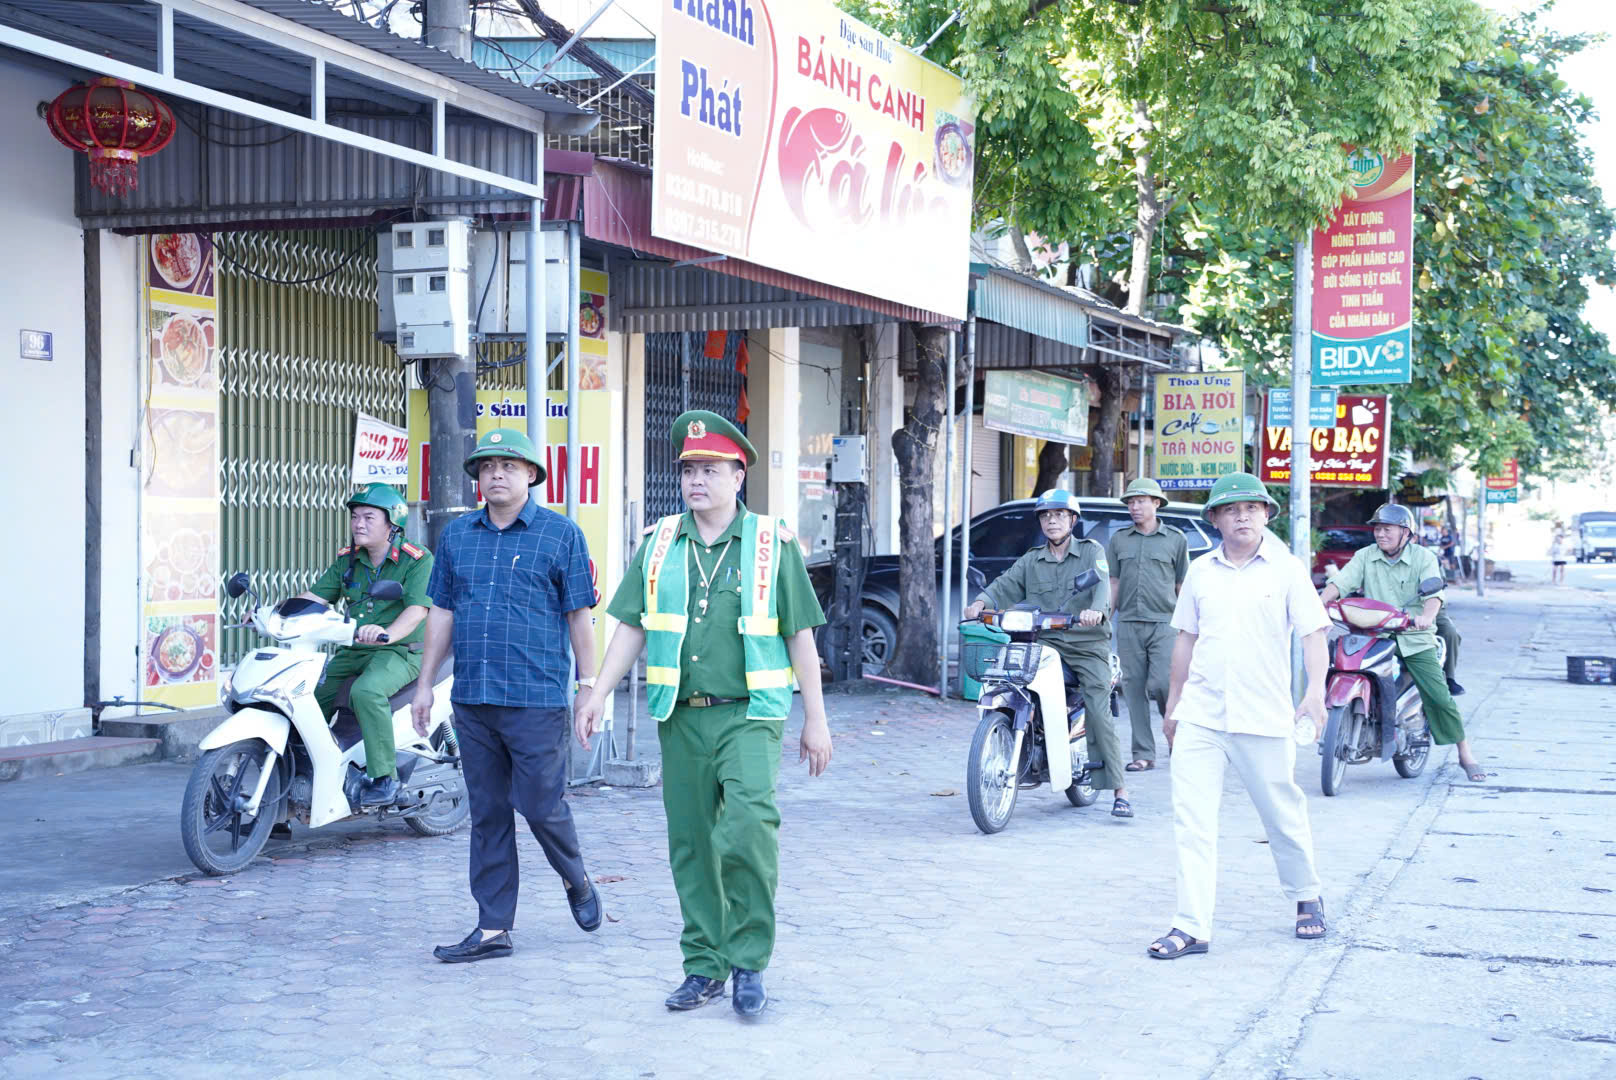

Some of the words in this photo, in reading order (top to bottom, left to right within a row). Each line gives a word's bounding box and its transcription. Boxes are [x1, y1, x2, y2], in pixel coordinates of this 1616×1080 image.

[673, 0, 754, 46] anh
[797, 35, 861, 102] BÁNH
[868, 74, 925, 132] CANH
[681, 59, 742, 136] Phát
[1343, 211, 1360, 226] XÂY
[1361, 210, 1384, 228] DỰNG
[1331, 232, 1354, 247] NÔNG
[1356, 230, 1377, 246] THÔN
[1378, 228, 1396, 245] MỚI
[1321, 252, 1338, 268] GÓP
[1363, 250, 1387, 266] NÂNG
[1388, 250, 1405, 264] CAO
[1339, 270, 1361, 288] SỐNG
[1363, 270, 1378, 289] VẬT
[1341, 294, 1360, 308] TINH
[1329, 311, 1346, 328] CỦA
[1347, 311, 1371, 327] NHÂN
[1372, 310, 1389, 326] DÂN
[29, 334, 44, 350] 96
[1320, 344, 1383, 369] BIDV
[1168, 377, 1200, 386] Thoa
[1204, 376, 1231, 387] Ưng
[490, 399, 526, 417] sản
[1163, 393, 1196, 410] BIA
[1202, 390, 1236, 409] HƠI
[1161, 412, 1202, 436] Café
[387, 437, 408, 461] TH
[1161, 438, 1186, 455] TRÀ
[1191, 438, 1235, 455] NÓNG
[1332, 426, 1380, 459] BẠC
[1200, 463, 1217, 475] NEM
[649, 527, 673, 595] CSTT
[758, 530, 771, 600] CSTT
